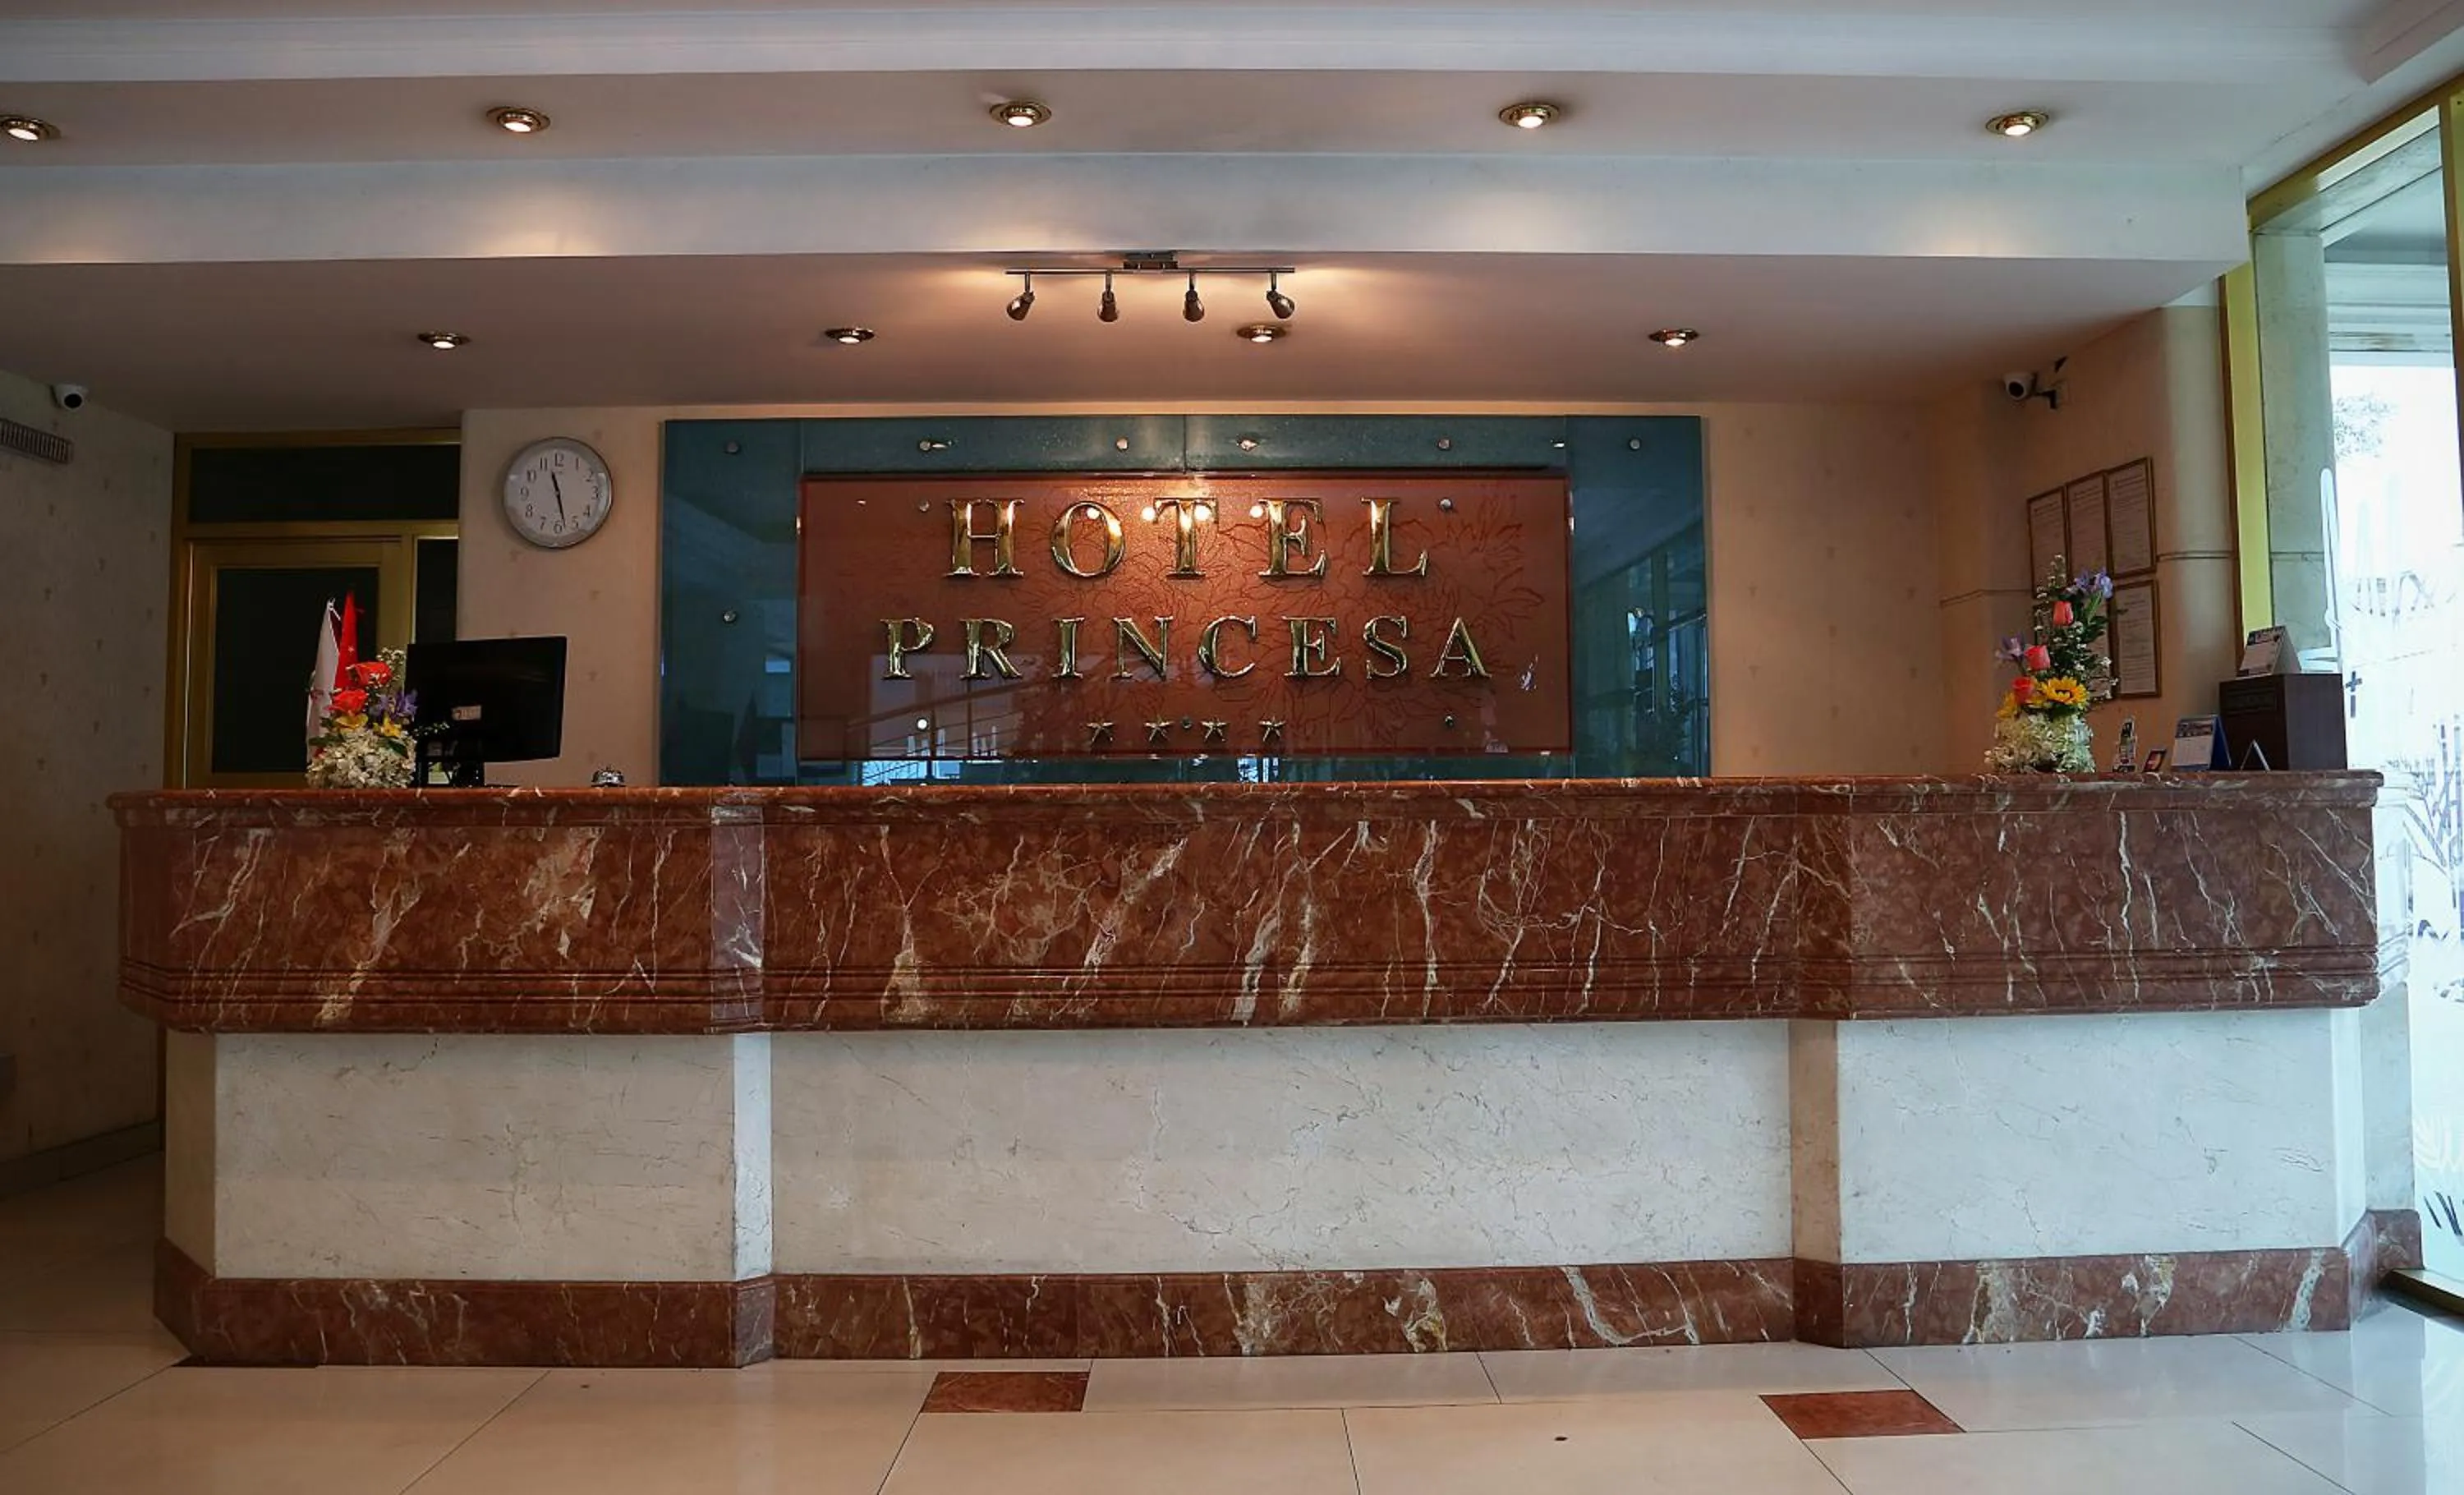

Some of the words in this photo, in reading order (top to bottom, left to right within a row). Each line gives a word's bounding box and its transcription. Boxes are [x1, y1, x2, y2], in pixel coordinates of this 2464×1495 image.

[539, 457, 548, 472] 11
[554, 453, 564, 467] 12
[526, 469, 536, 483] 10
[584, 468, 594, 482] 2
[520, 486, 530, 501] 9
[591, 485, 600, 500] 3
[525, 504, 533, 518] 8
[583, 504, 591, 518] 4
[540, 516, 547, 531] 7
[553, 519, 563, 534] 6
[572, 515, 579, 529] 5
[945, 496, 1430, 577] HOTEL
[880, 615, 1492, 680] PRINCESA
